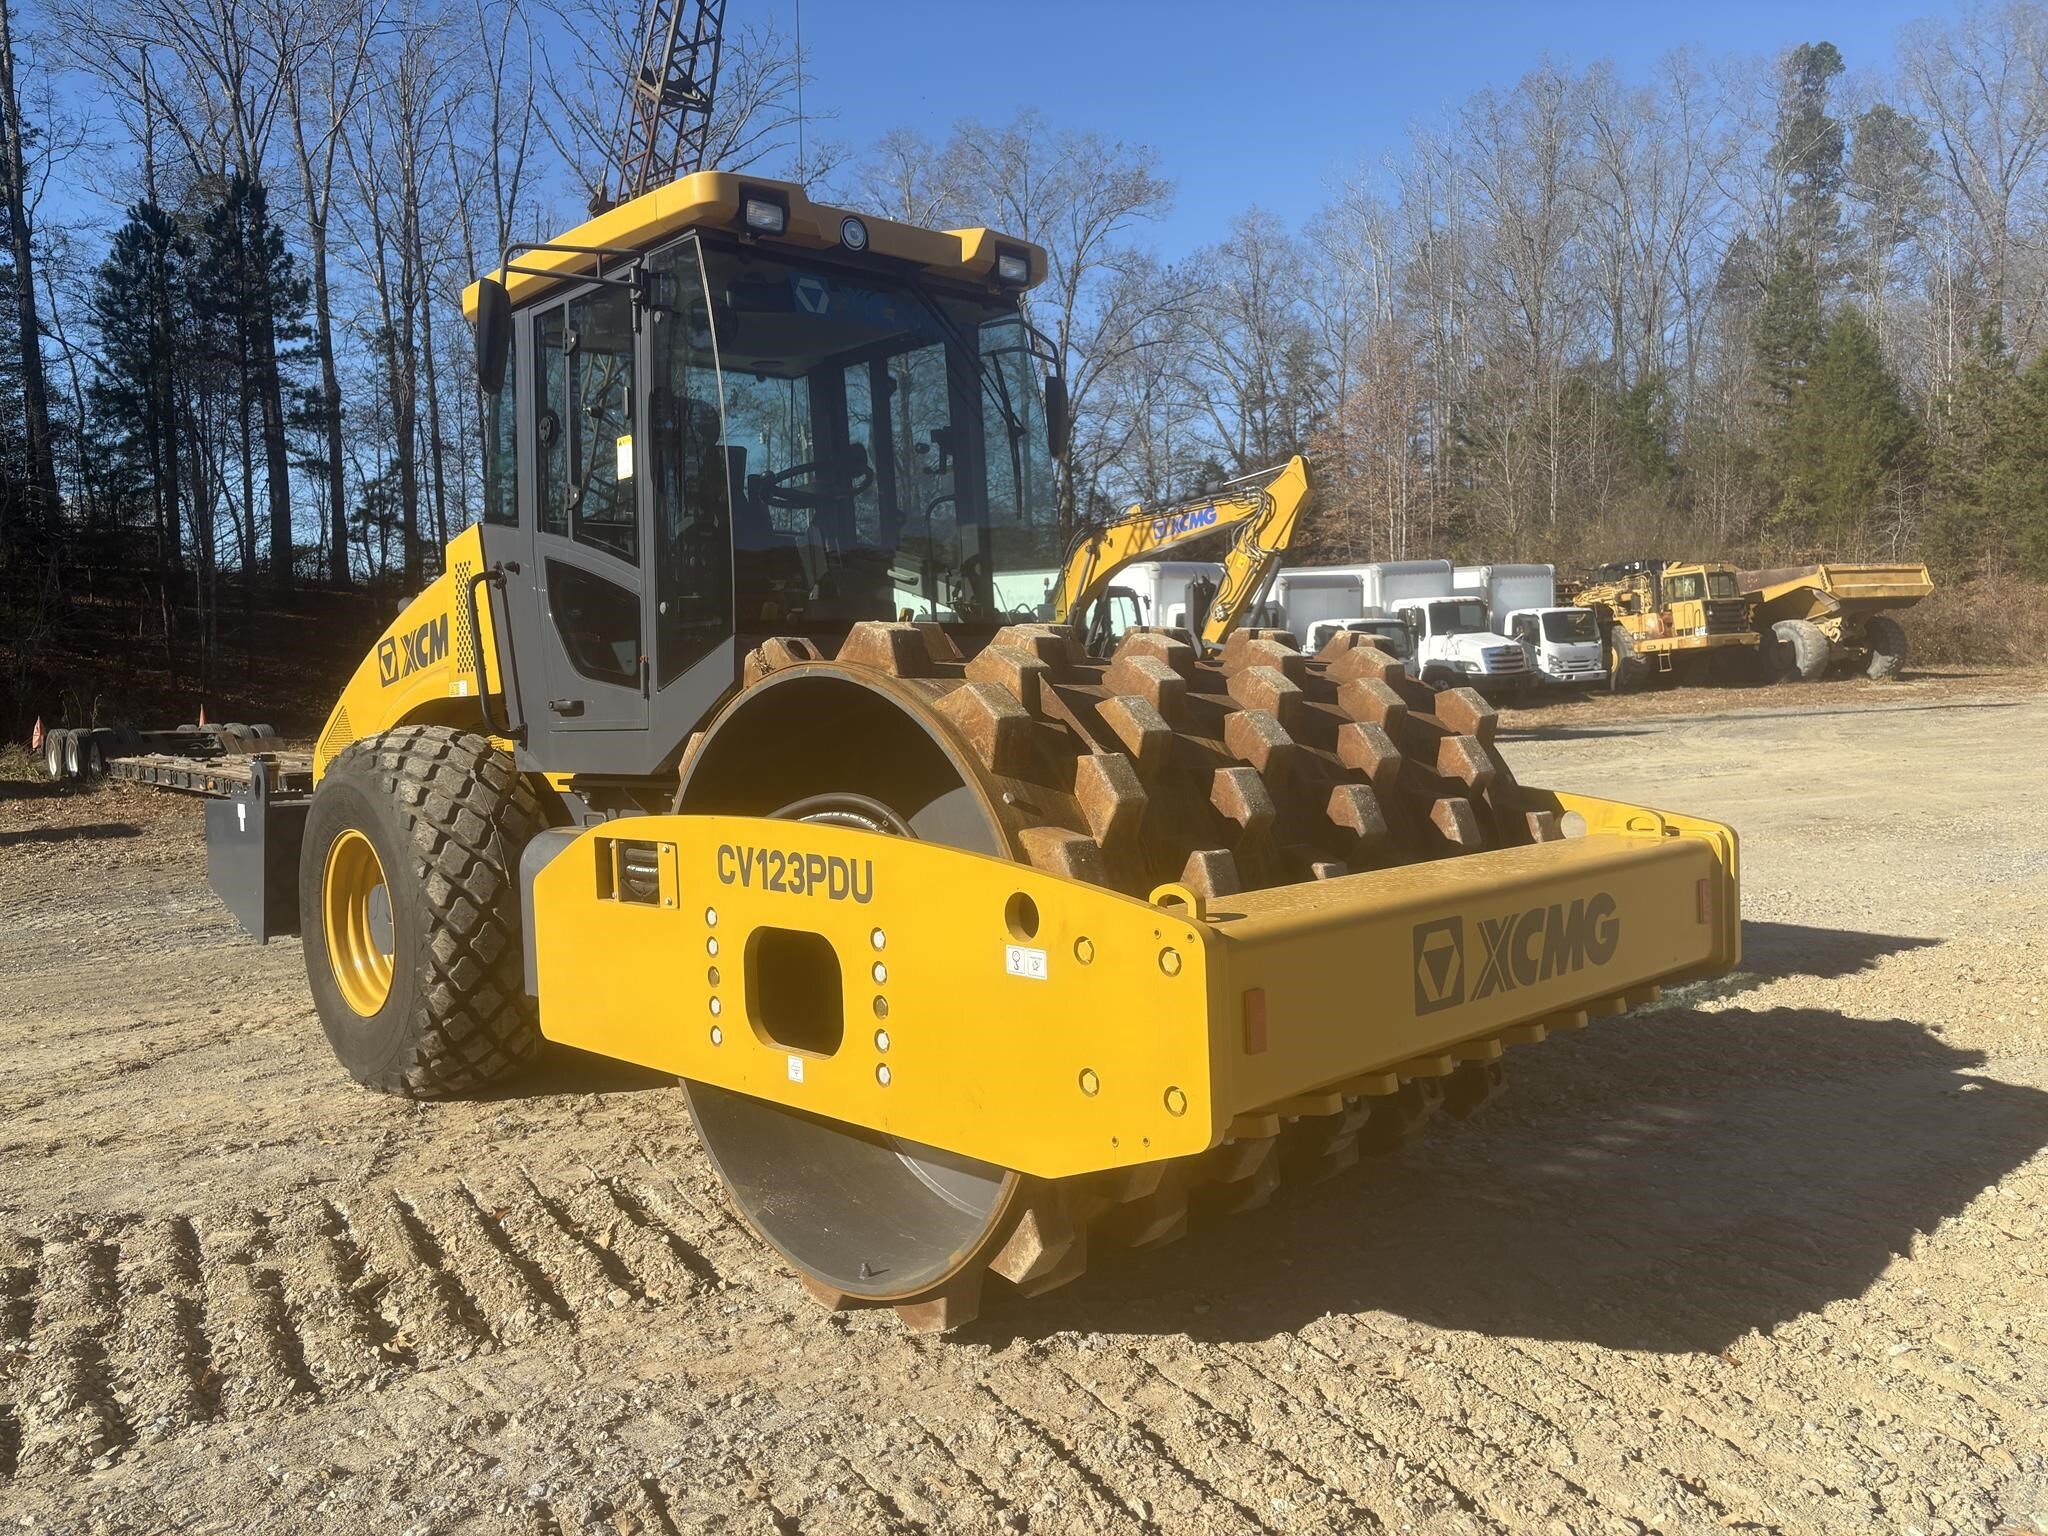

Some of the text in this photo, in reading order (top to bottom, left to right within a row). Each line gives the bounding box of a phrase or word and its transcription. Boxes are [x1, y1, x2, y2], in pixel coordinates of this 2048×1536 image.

[1169, 507, 1217, 536] XCMG
[717, 844, 873, 904] CV123PDU
[1470, 892, 1620, 1001] XCMG
